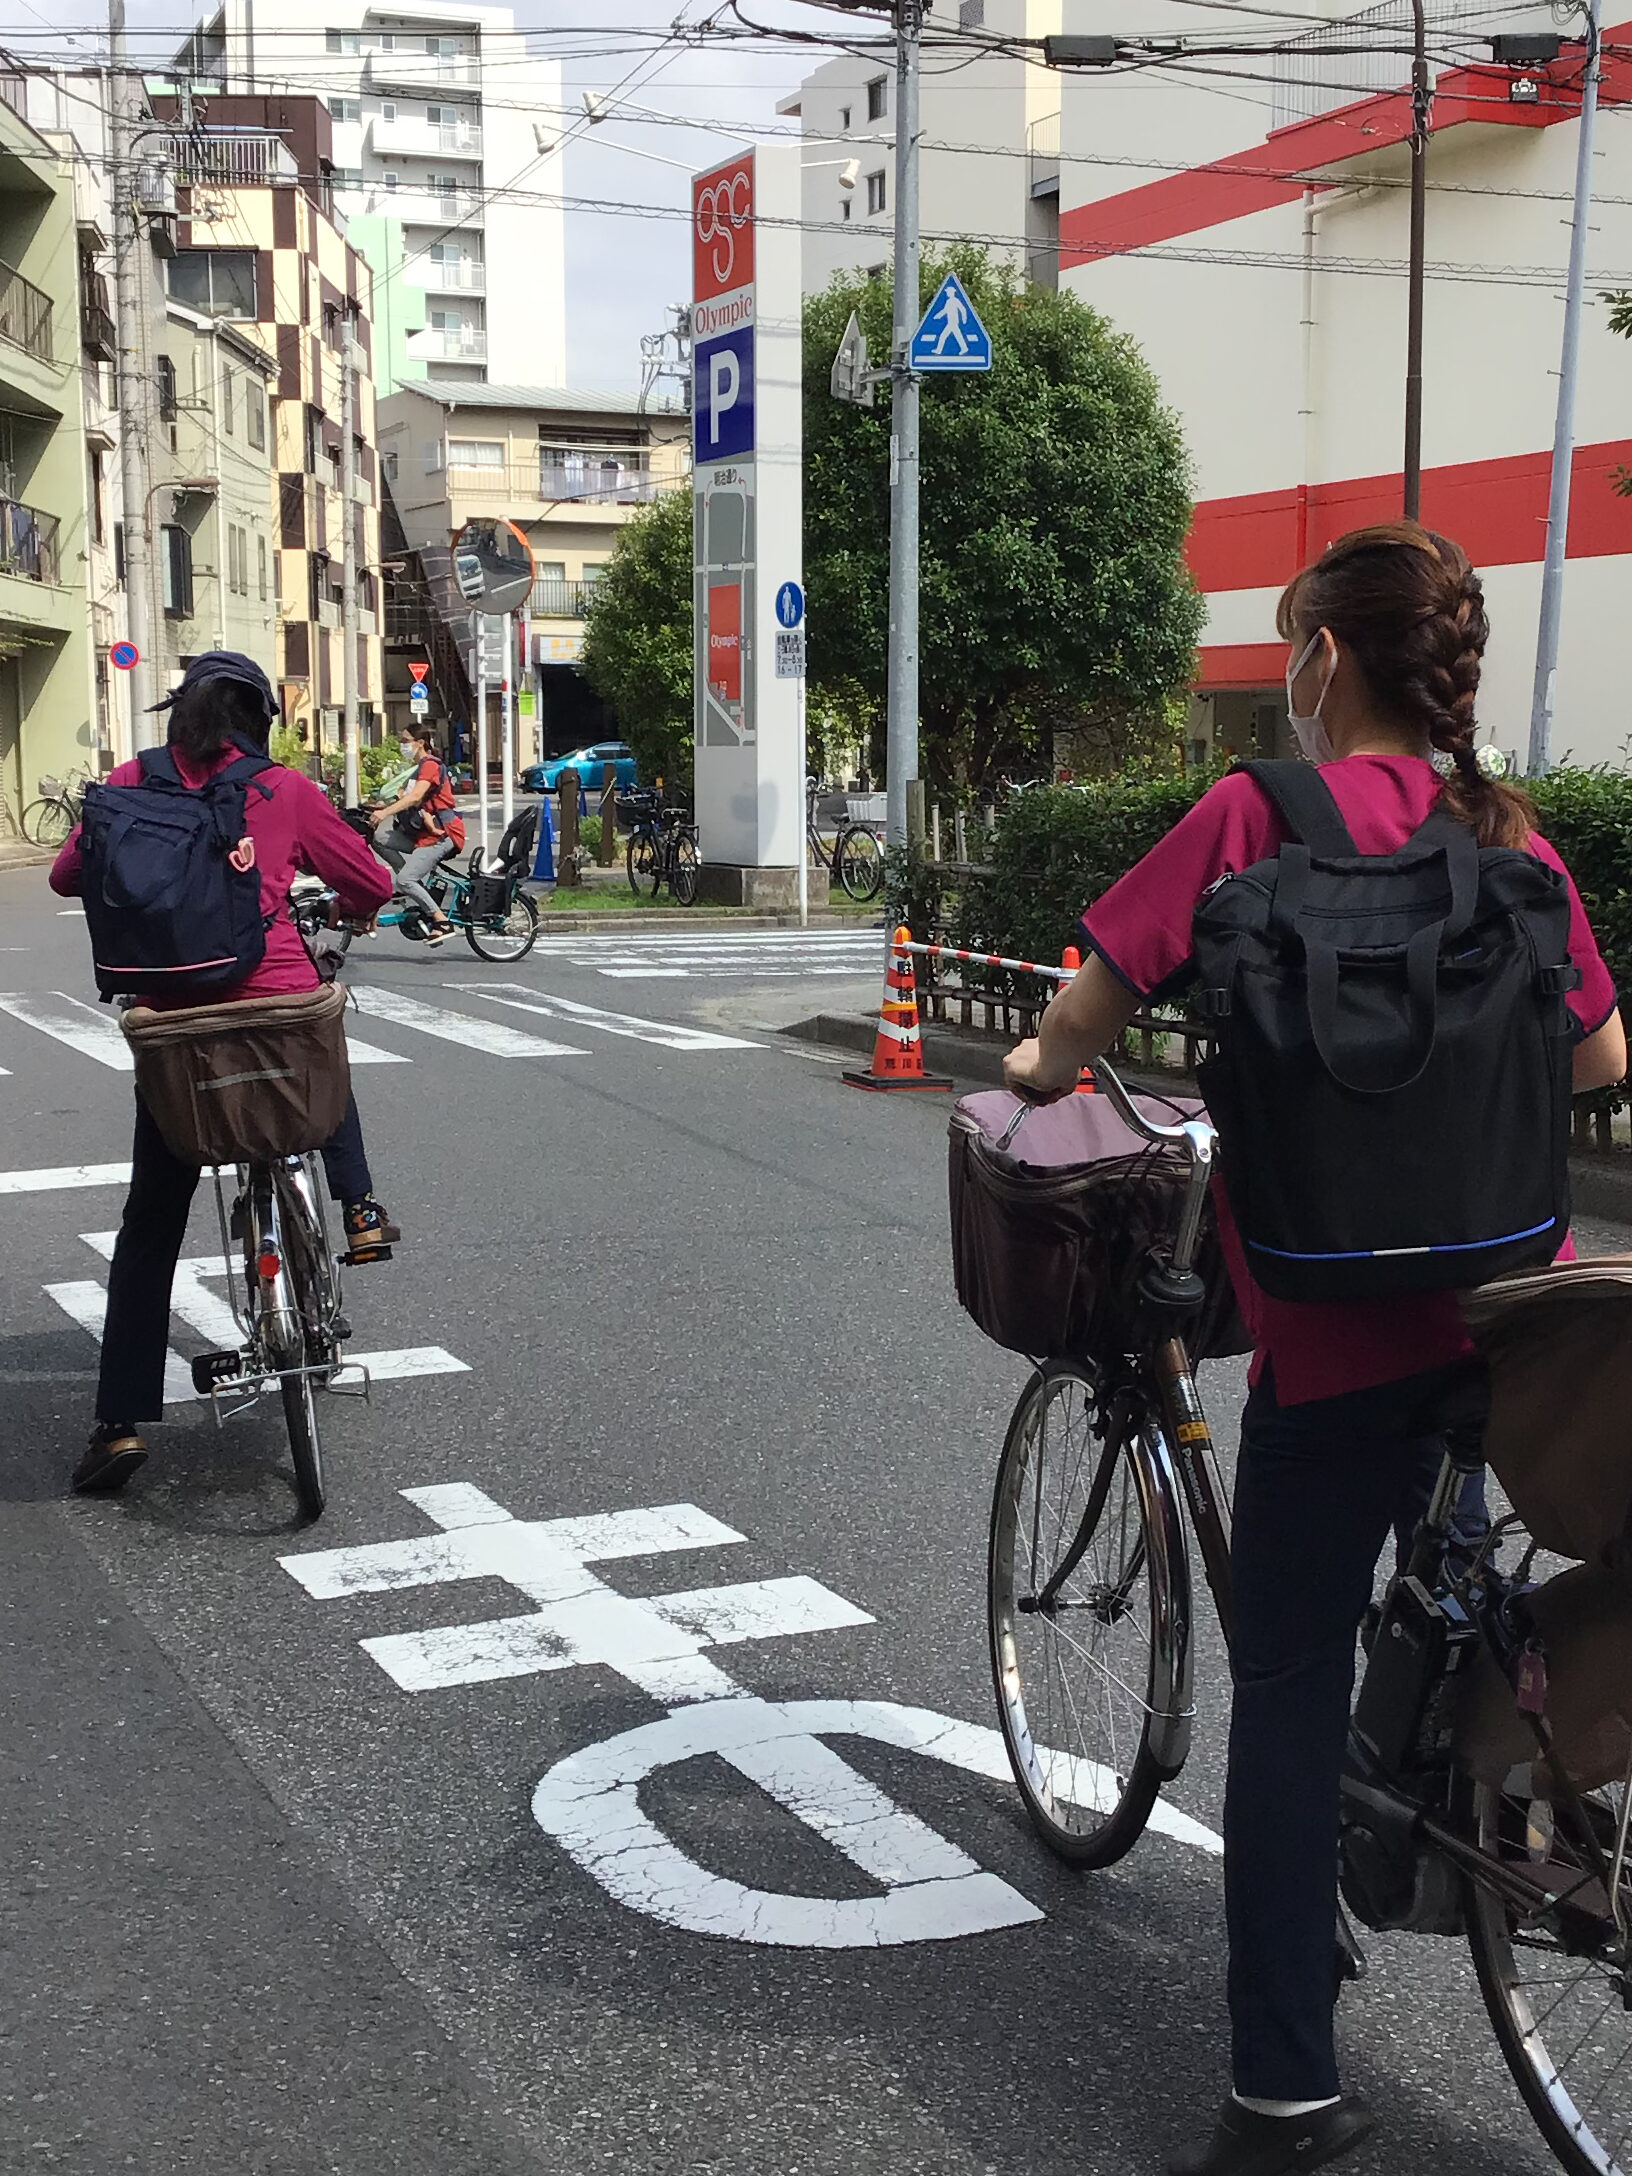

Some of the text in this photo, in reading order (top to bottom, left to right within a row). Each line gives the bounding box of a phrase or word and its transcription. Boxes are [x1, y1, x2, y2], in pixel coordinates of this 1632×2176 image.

[695, 294, 752, 334] Olympic
[709, 349, 740, 445] P
[710, 633, 738, 648] Olympic
[1181, 1446, 1207, 1515] Panasonic
